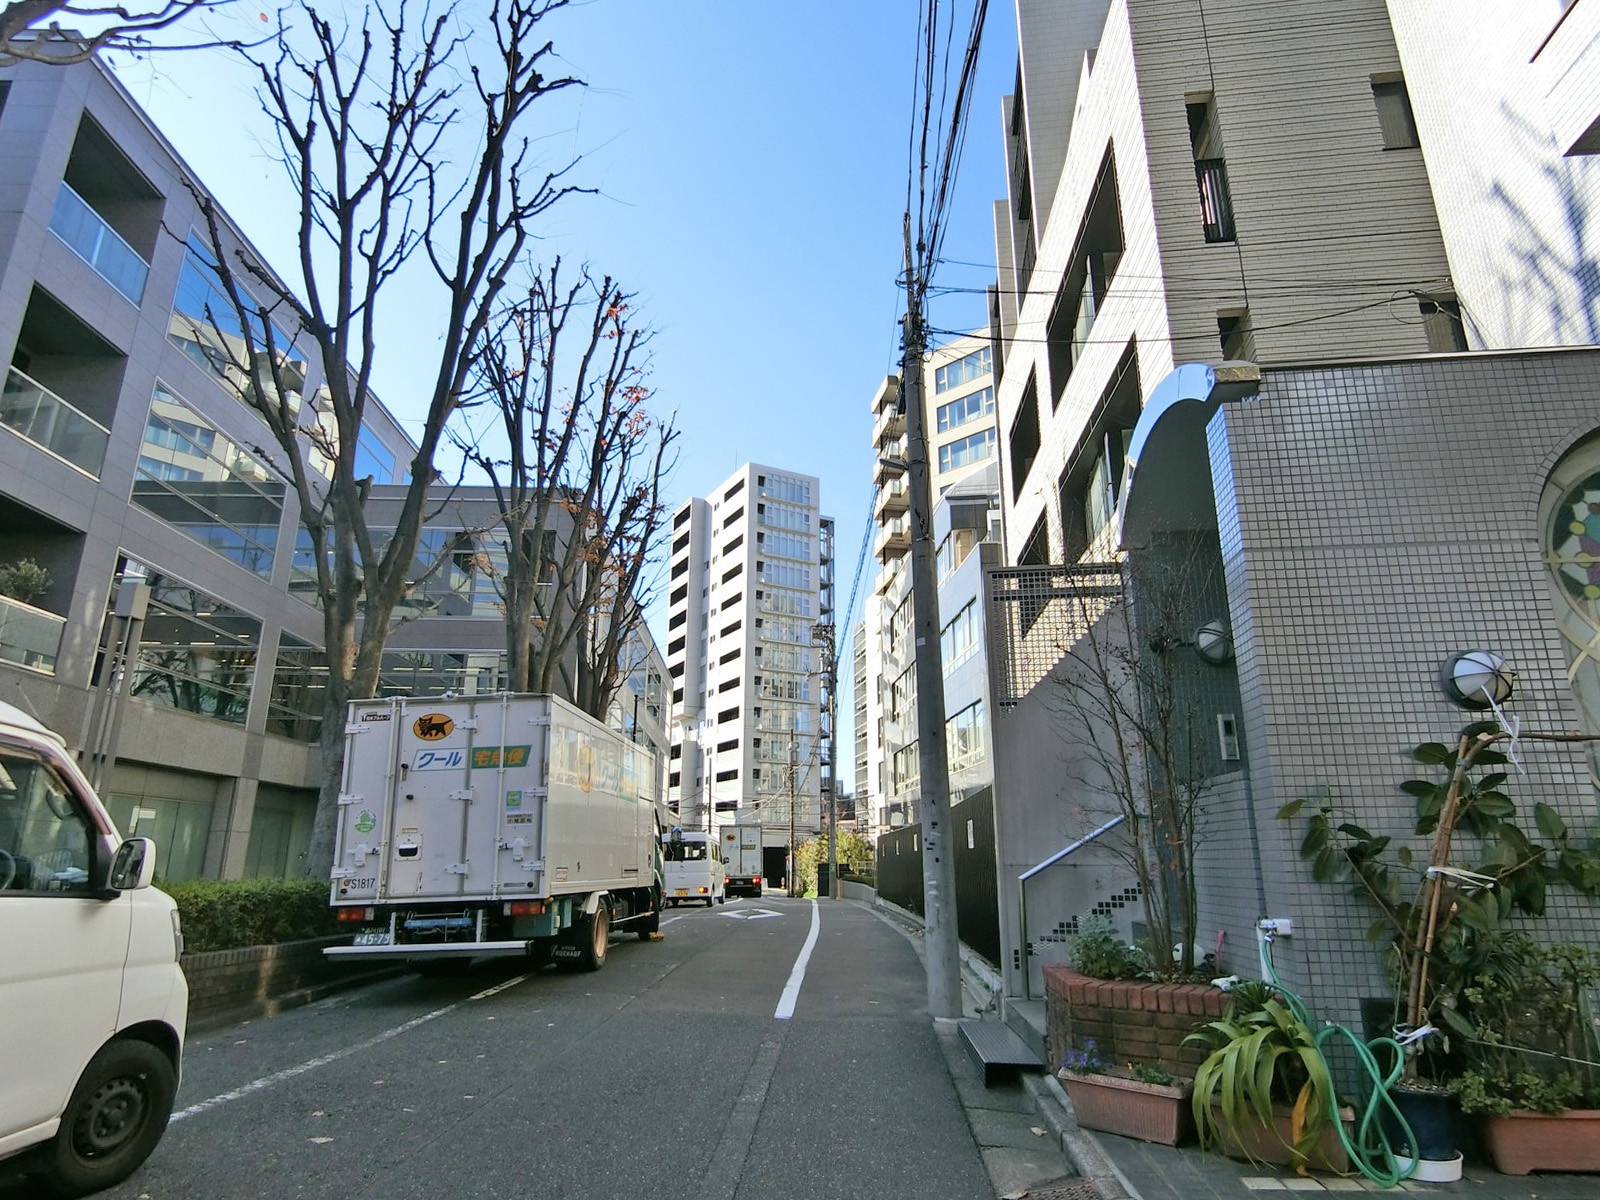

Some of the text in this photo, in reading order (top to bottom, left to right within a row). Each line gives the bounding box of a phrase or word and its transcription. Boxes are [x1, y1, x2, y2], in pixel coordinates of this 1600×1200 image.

[418, 751, 463, 768] クール
[350, 878, 375, 889] S1817
